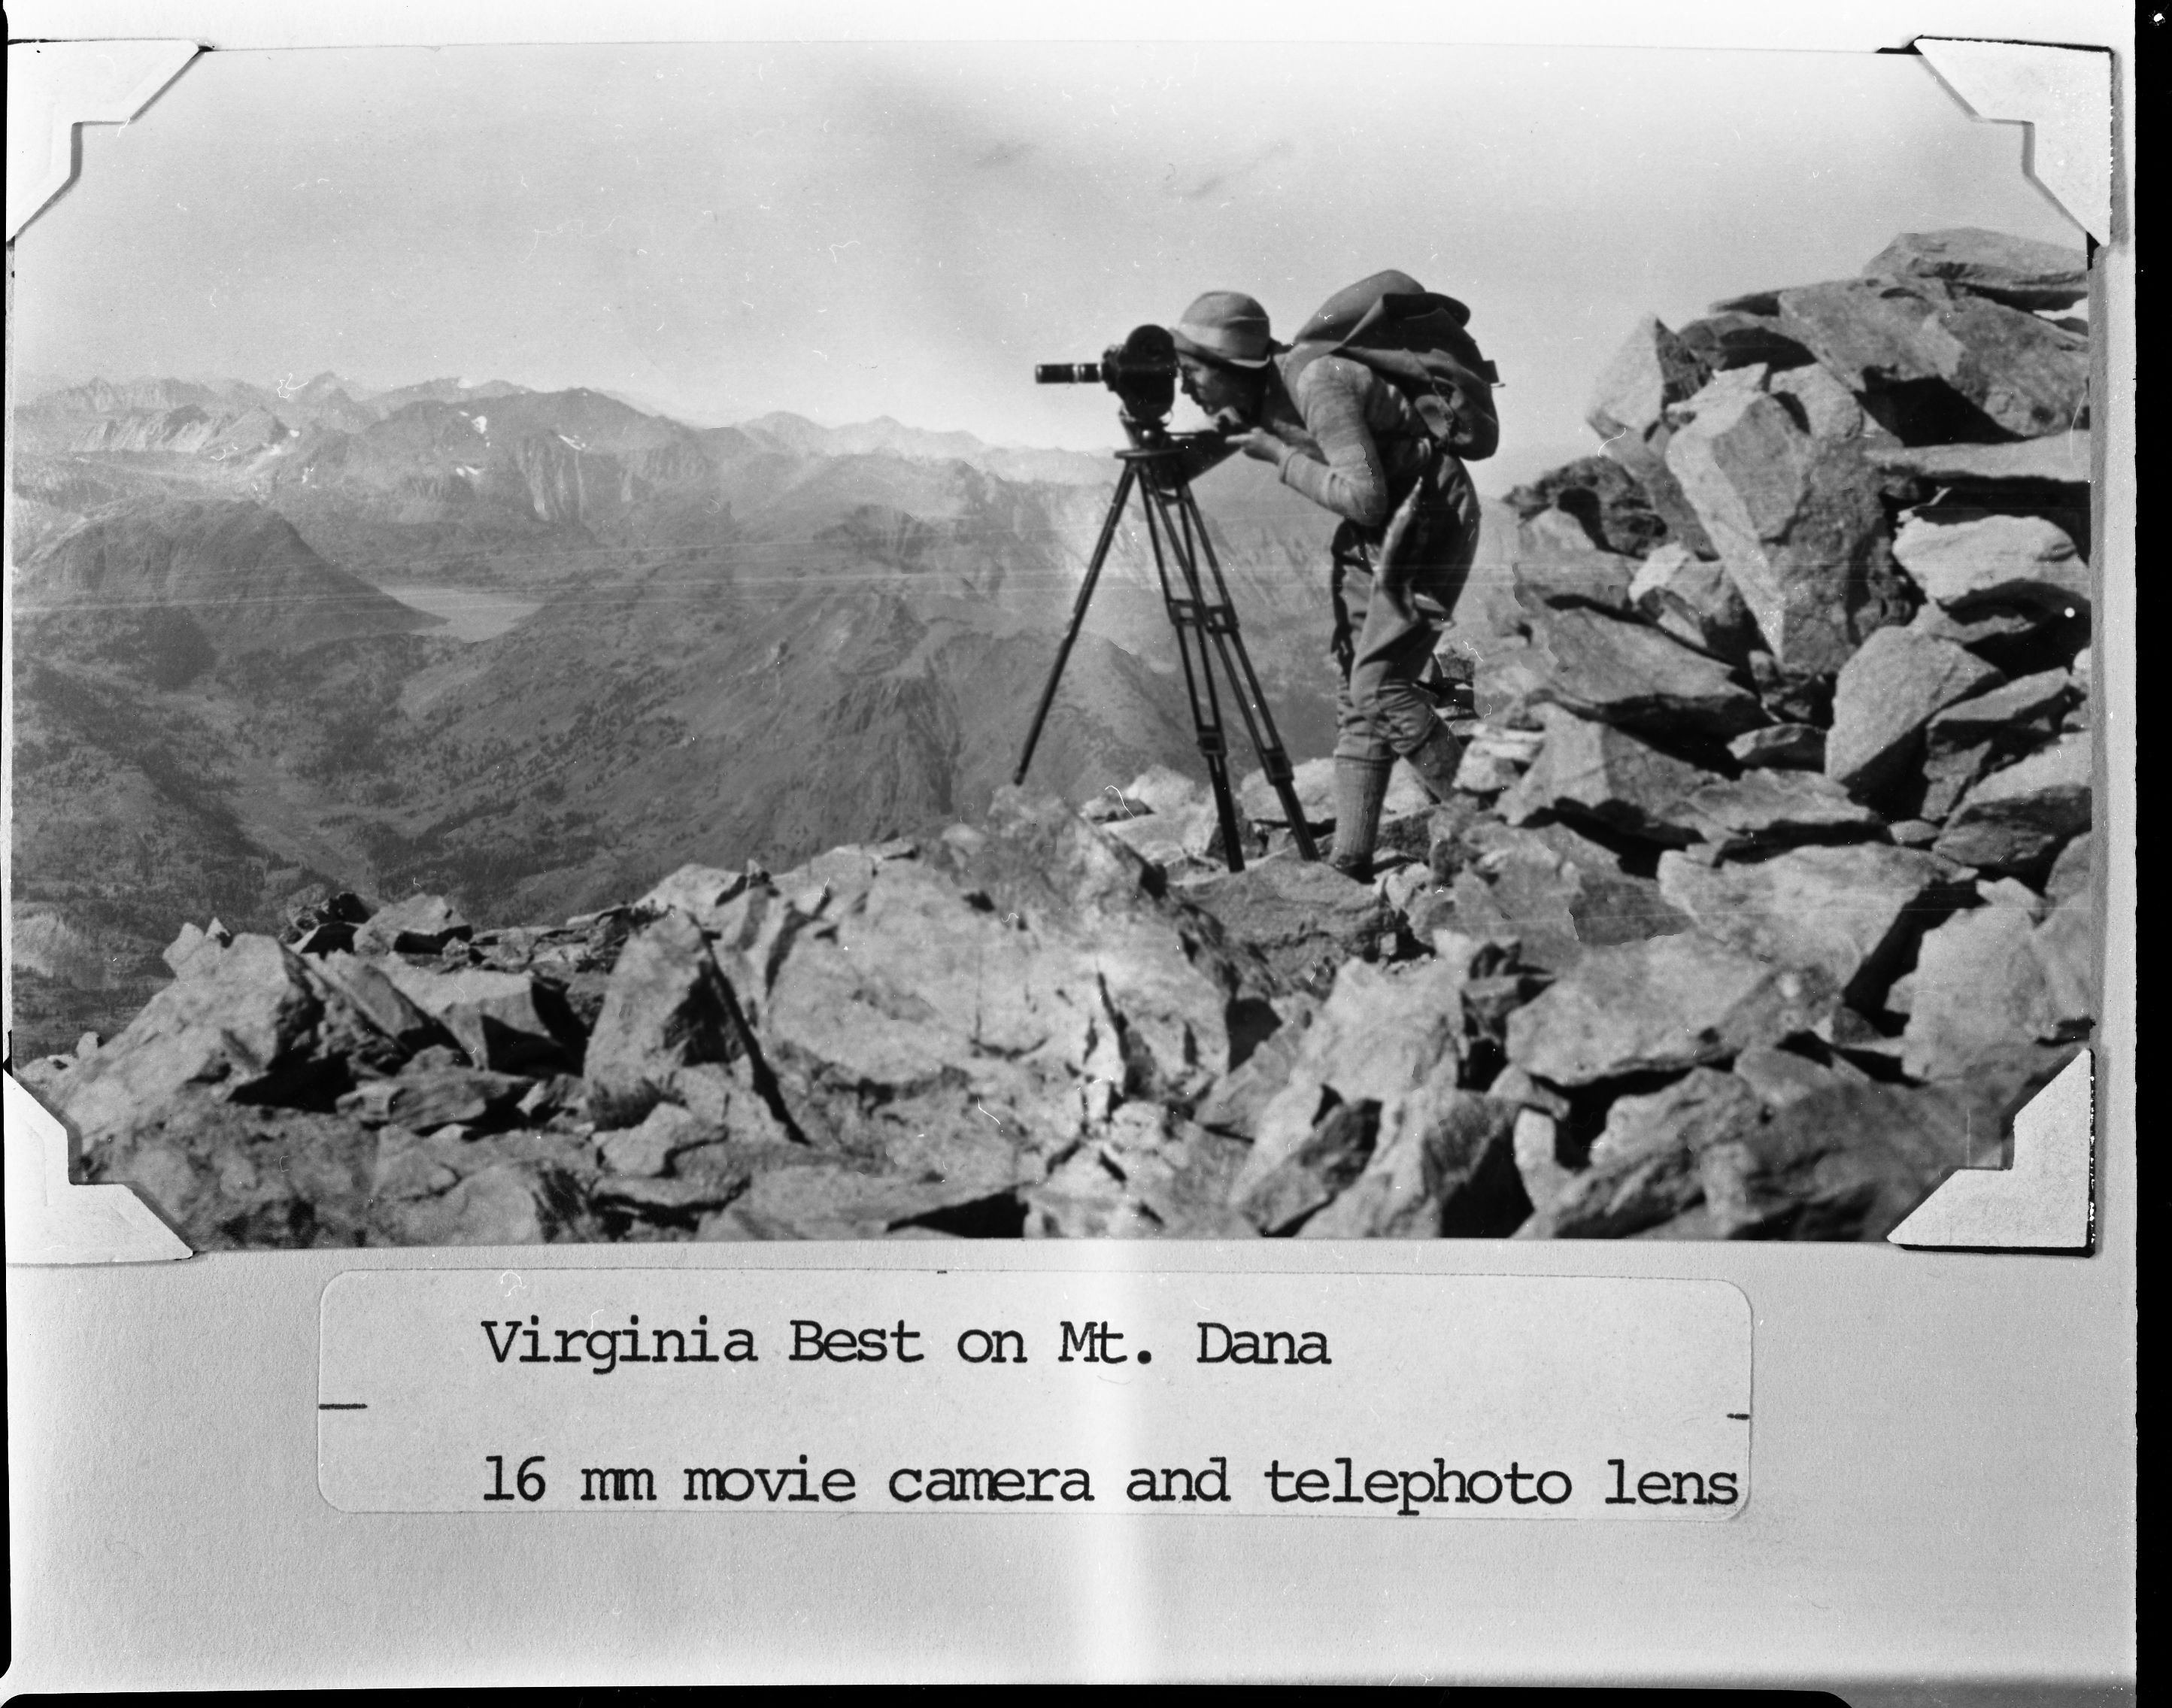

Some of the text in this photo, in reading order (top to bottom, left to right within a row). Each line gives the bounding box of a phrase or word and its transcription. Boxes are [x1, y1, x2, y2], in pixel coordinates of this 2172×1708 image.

[481, 1315, 1333, 1375] Virginia Best on Mt. Dana
[484, 1454, 1739, 1516] 16 mm movie camera and telephoto lens
